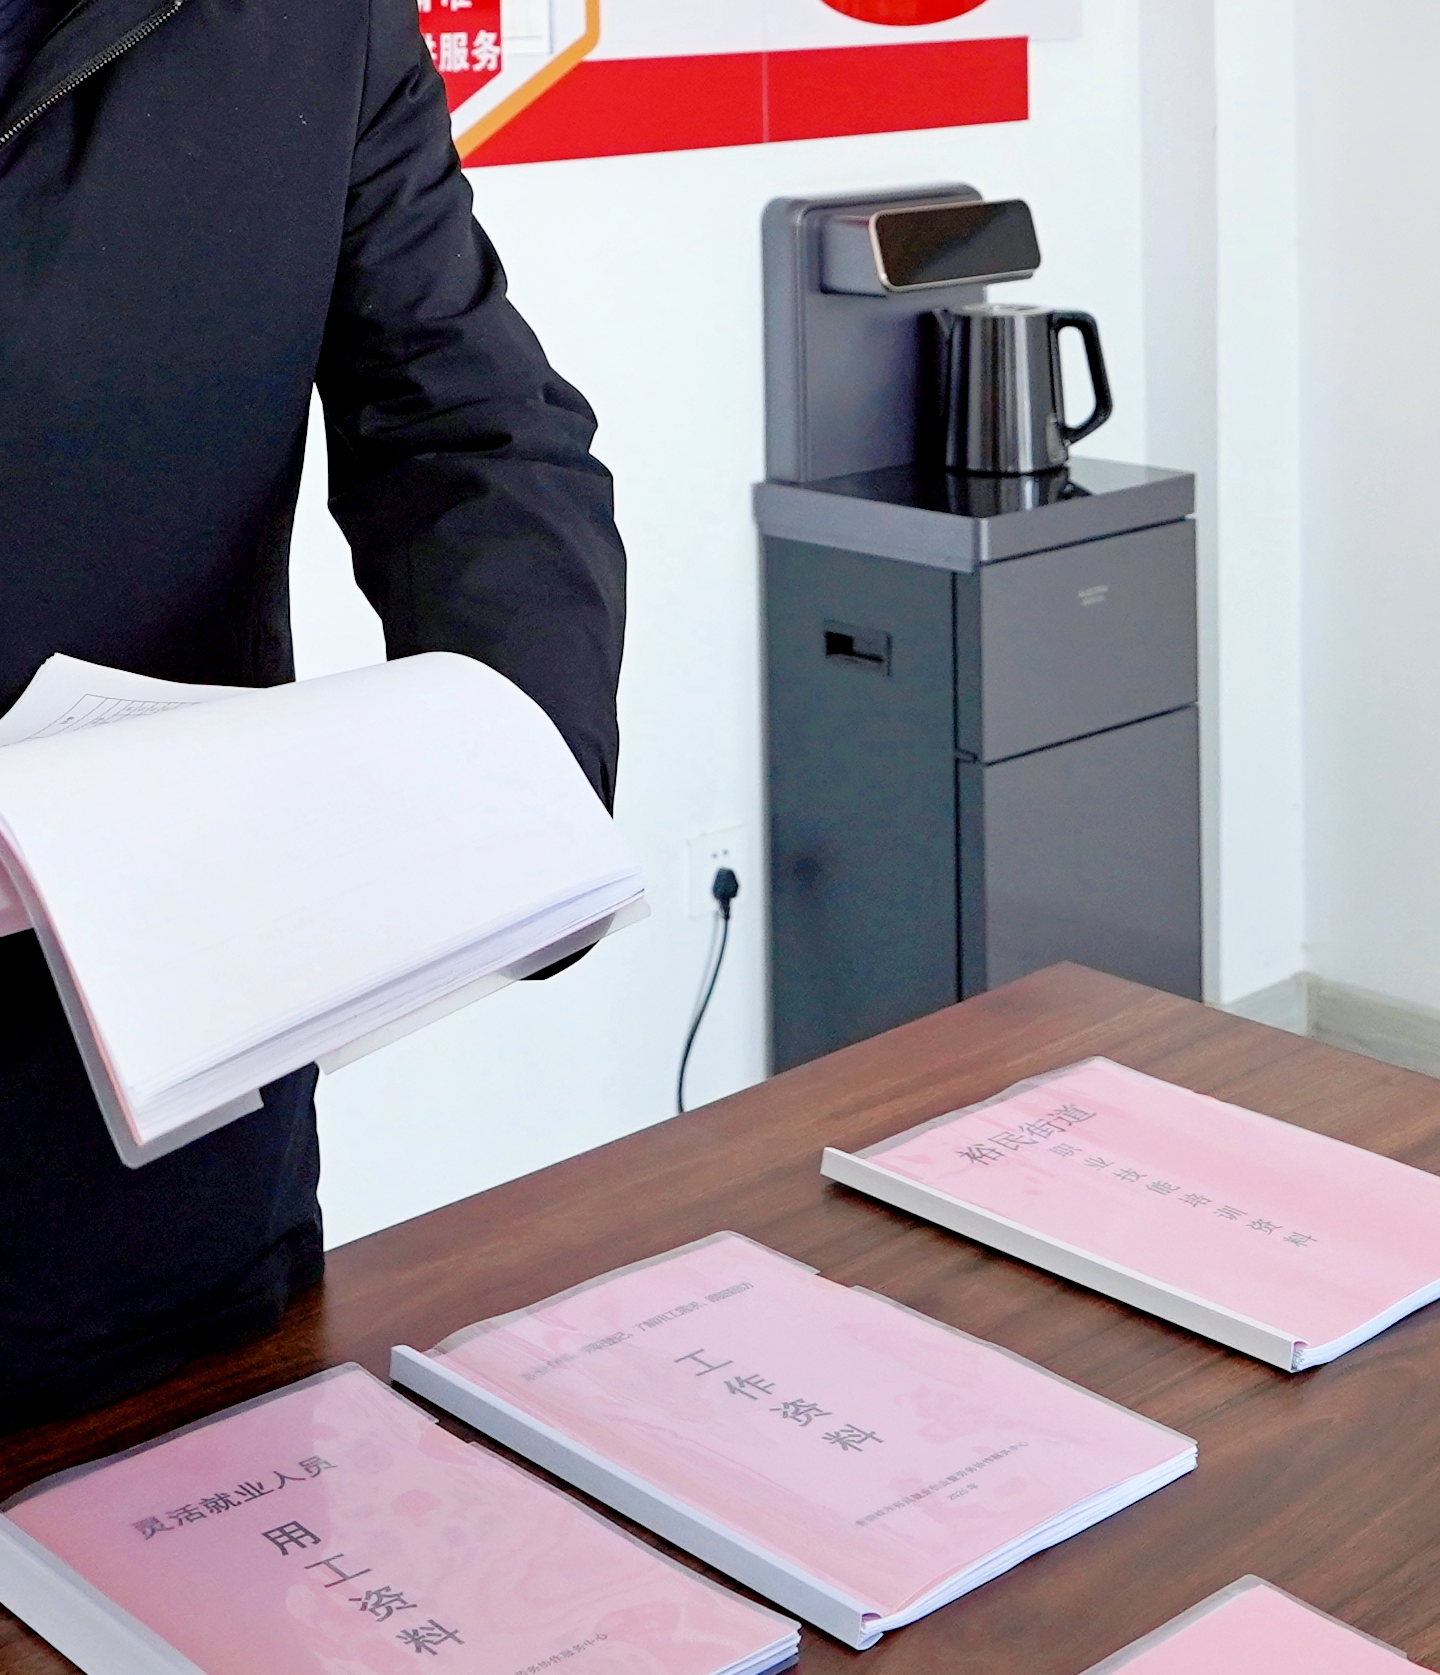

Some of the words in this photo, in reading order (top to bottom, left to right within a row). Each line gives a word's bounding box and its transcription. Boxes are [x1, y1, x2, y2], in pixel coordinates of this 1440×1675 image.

[959, 1103, 1097, 1166] 裕民街道
[673, 1347, 885, 1453] 工作资料
[260, 1520, 466, 1659] 用工资料
